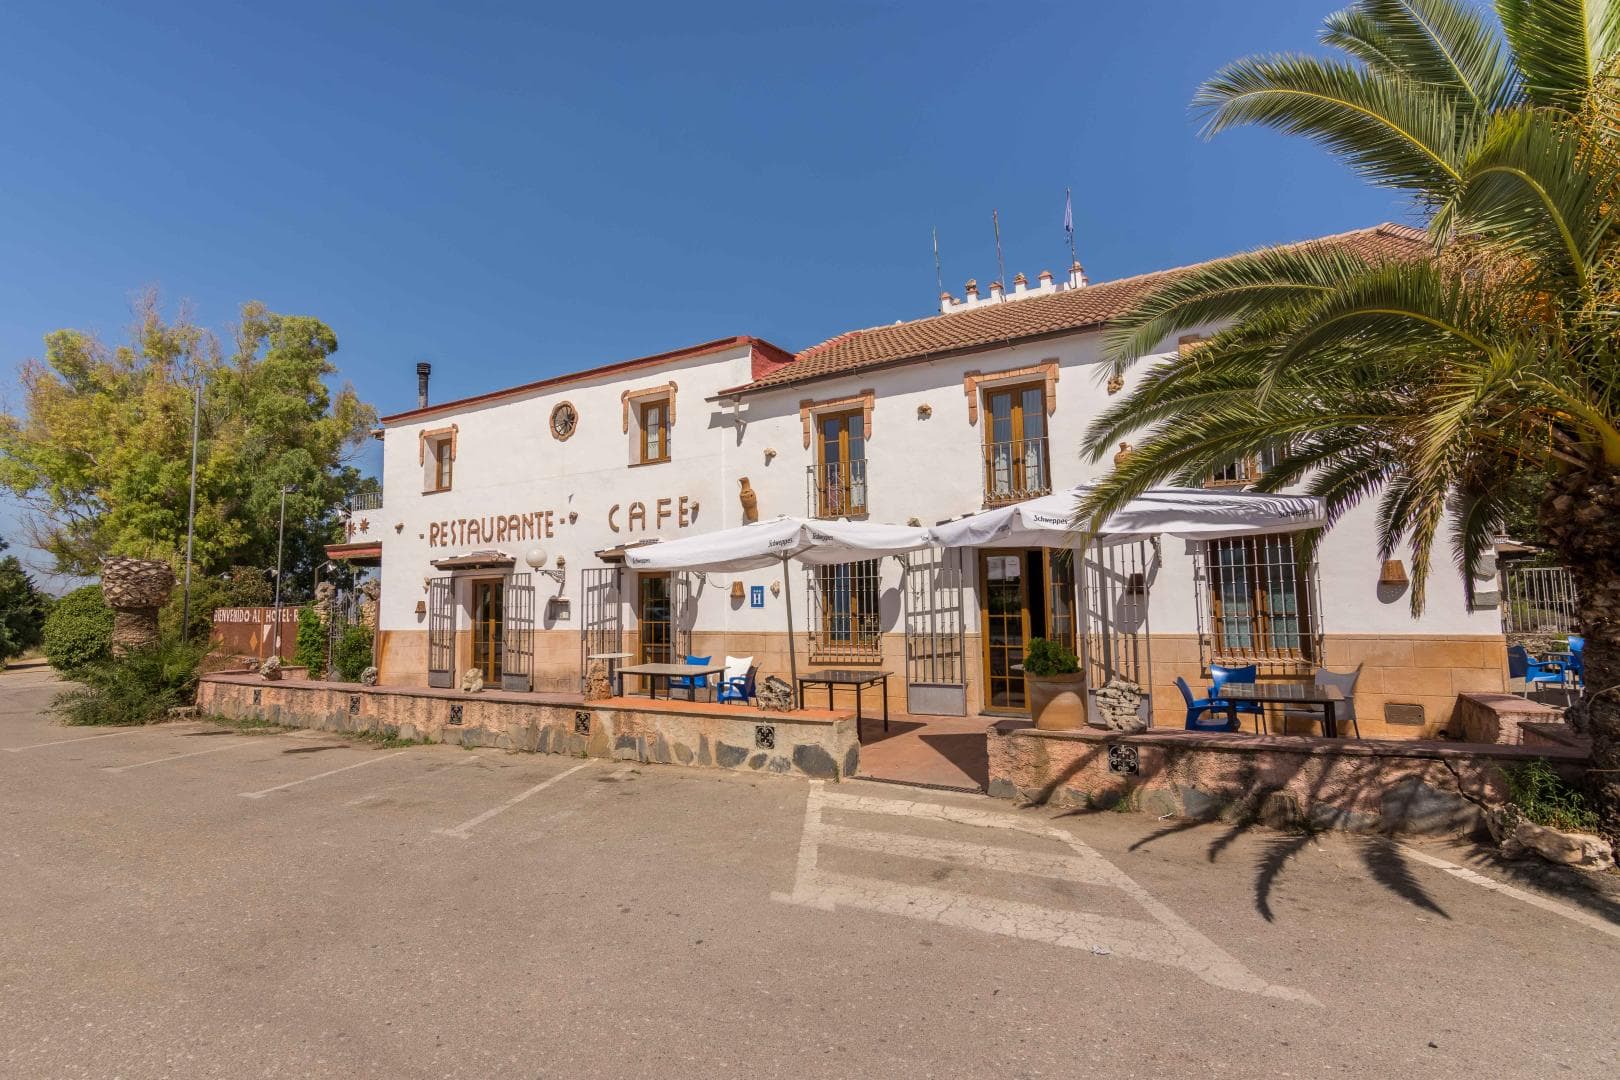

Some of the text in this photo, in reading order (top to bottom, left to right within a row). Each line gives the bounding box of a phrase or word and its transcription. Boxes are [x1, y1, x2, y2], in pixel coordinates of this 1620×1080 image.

[608, 495, 689, 533] CAFE
[1033, 514, 1068, 526] Schweppes
[429, 510, 554, 548] RESTAURANTE
[213, 609, 250, 622] BIENVENIDO
[252, 609, 261, 623] AL
[265, 609, 290, 623] HOTEL
